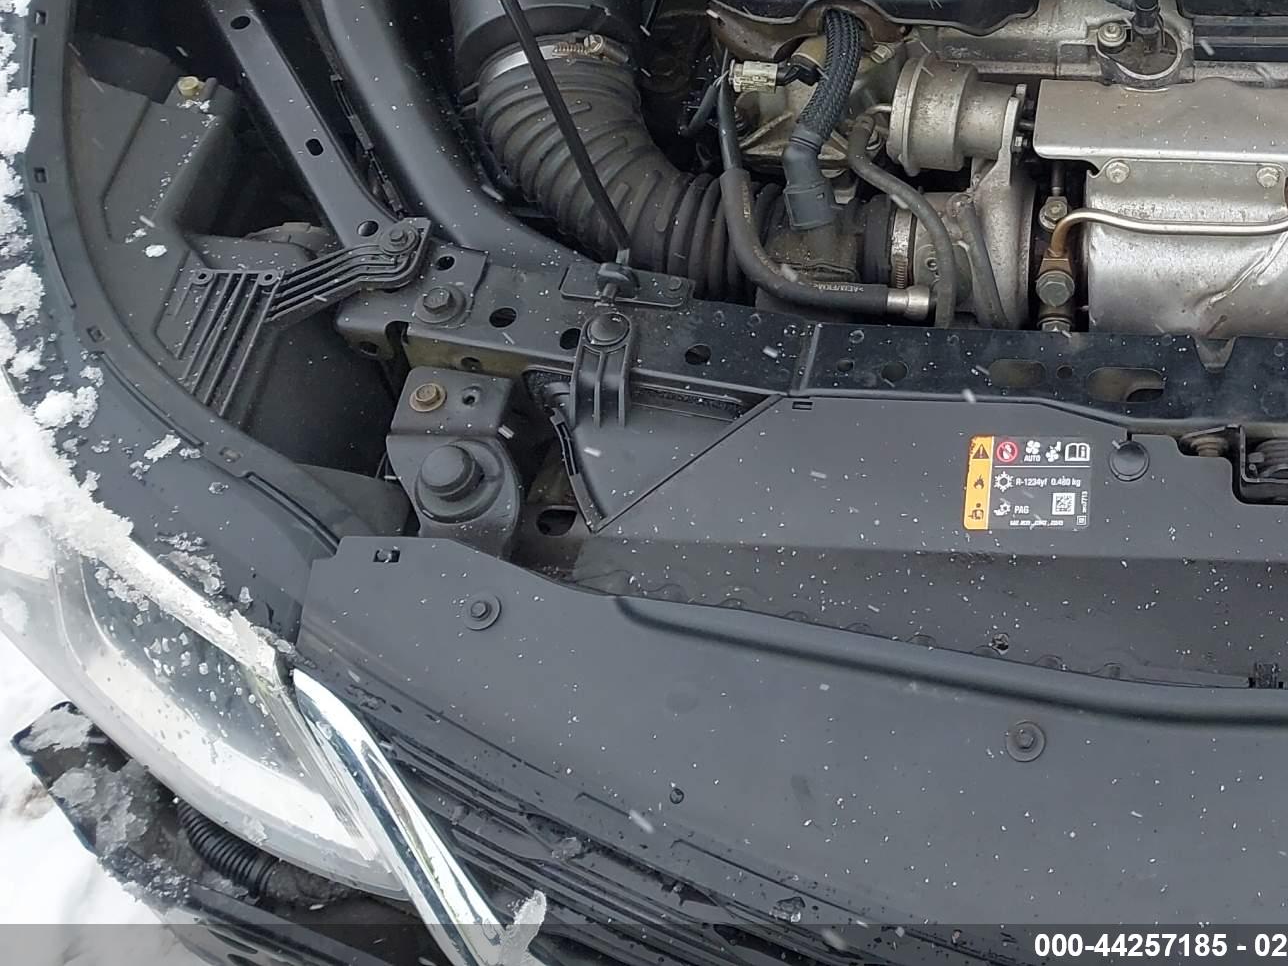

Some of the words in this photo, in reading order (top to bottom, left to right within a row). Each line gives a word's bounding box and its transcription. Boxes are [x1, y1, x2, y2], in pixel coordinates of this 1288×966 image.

[1015, 477, 1048, 487] R-1234yf
[1072, 477, 1081, 487] kg
[1014, 505, 1029, 513] PAG
